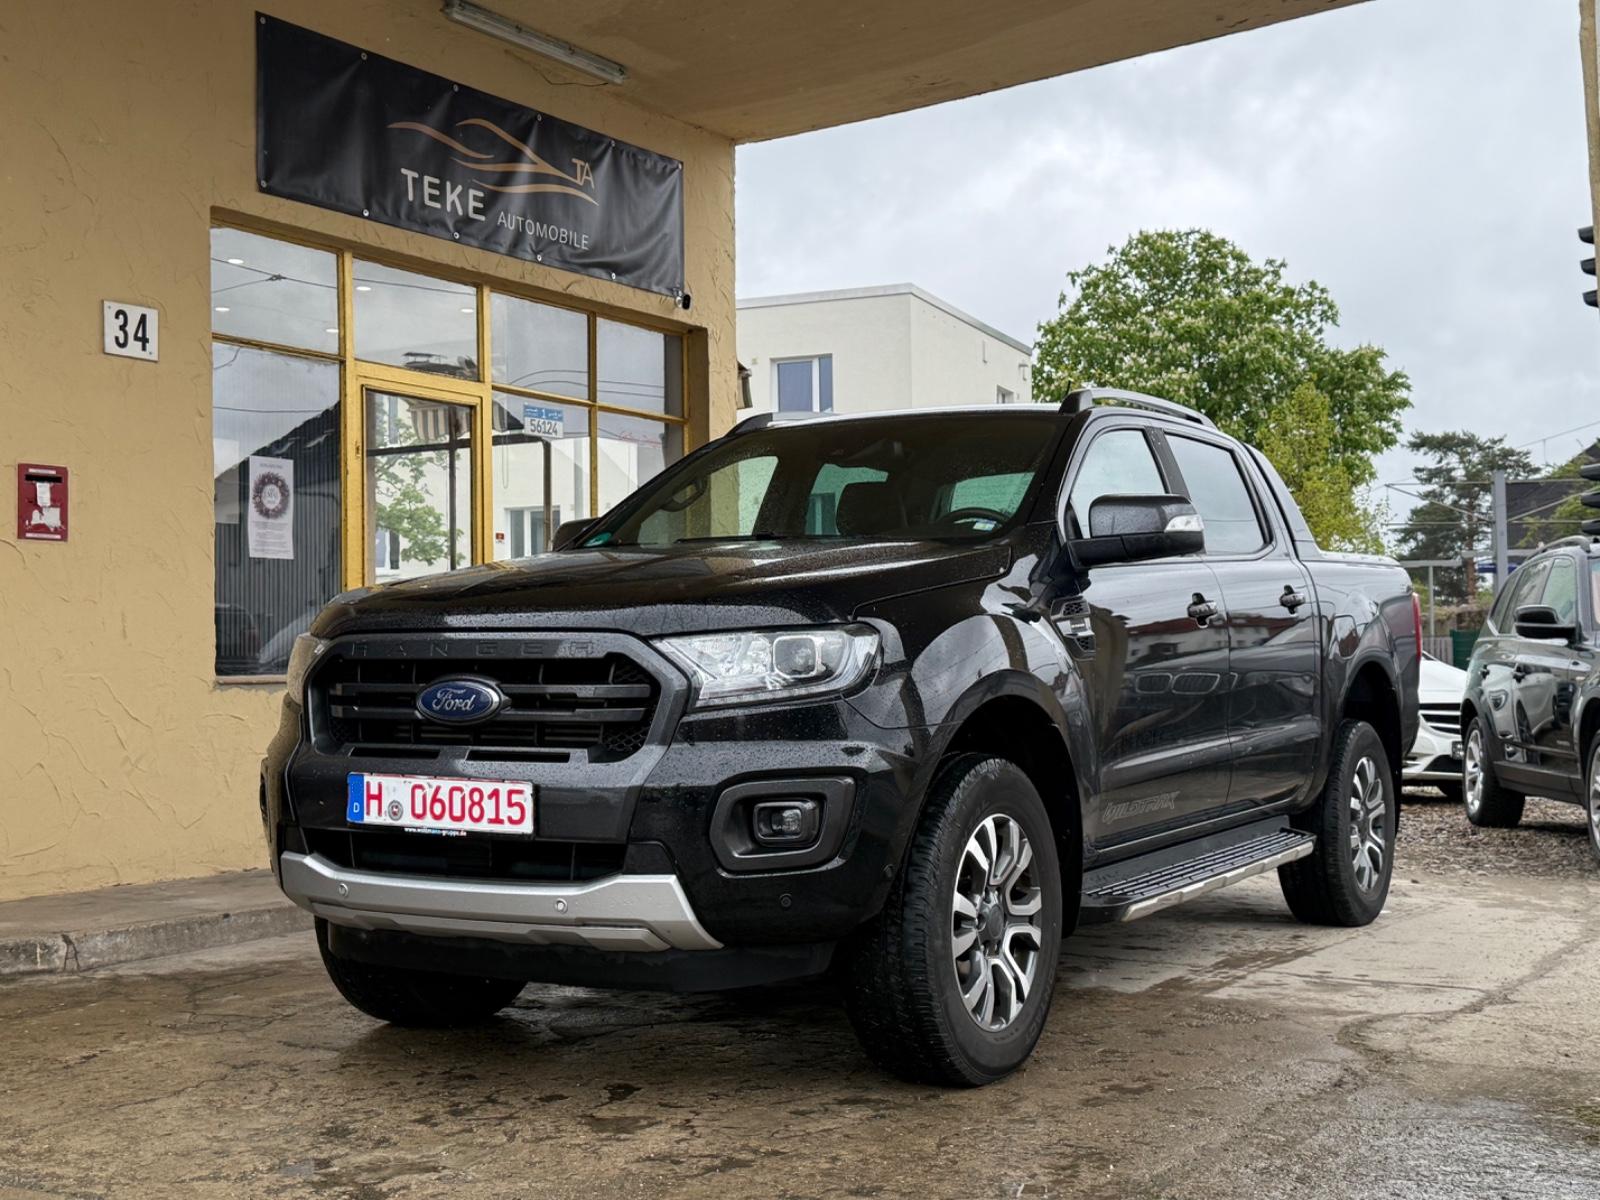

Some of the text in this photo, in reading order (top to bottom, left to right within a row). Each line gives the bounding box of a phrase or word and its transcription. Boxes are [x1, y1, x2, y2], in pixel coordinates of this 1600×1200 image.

[401, 168, 486, 222] TEKE
[497, 211, 589, 250] AUTOMOBILE
[114, 308, 150, 352] 34
[529, 418, 558, 436] 56124
[351, 639, 596, 657] RANGER
[431, 688, 475, 712] Ford
[353, 802, 361, 813] D
[366, 781, 527, 826] H 060815
[1102, 790, 1181, 824] WILDTRAK
